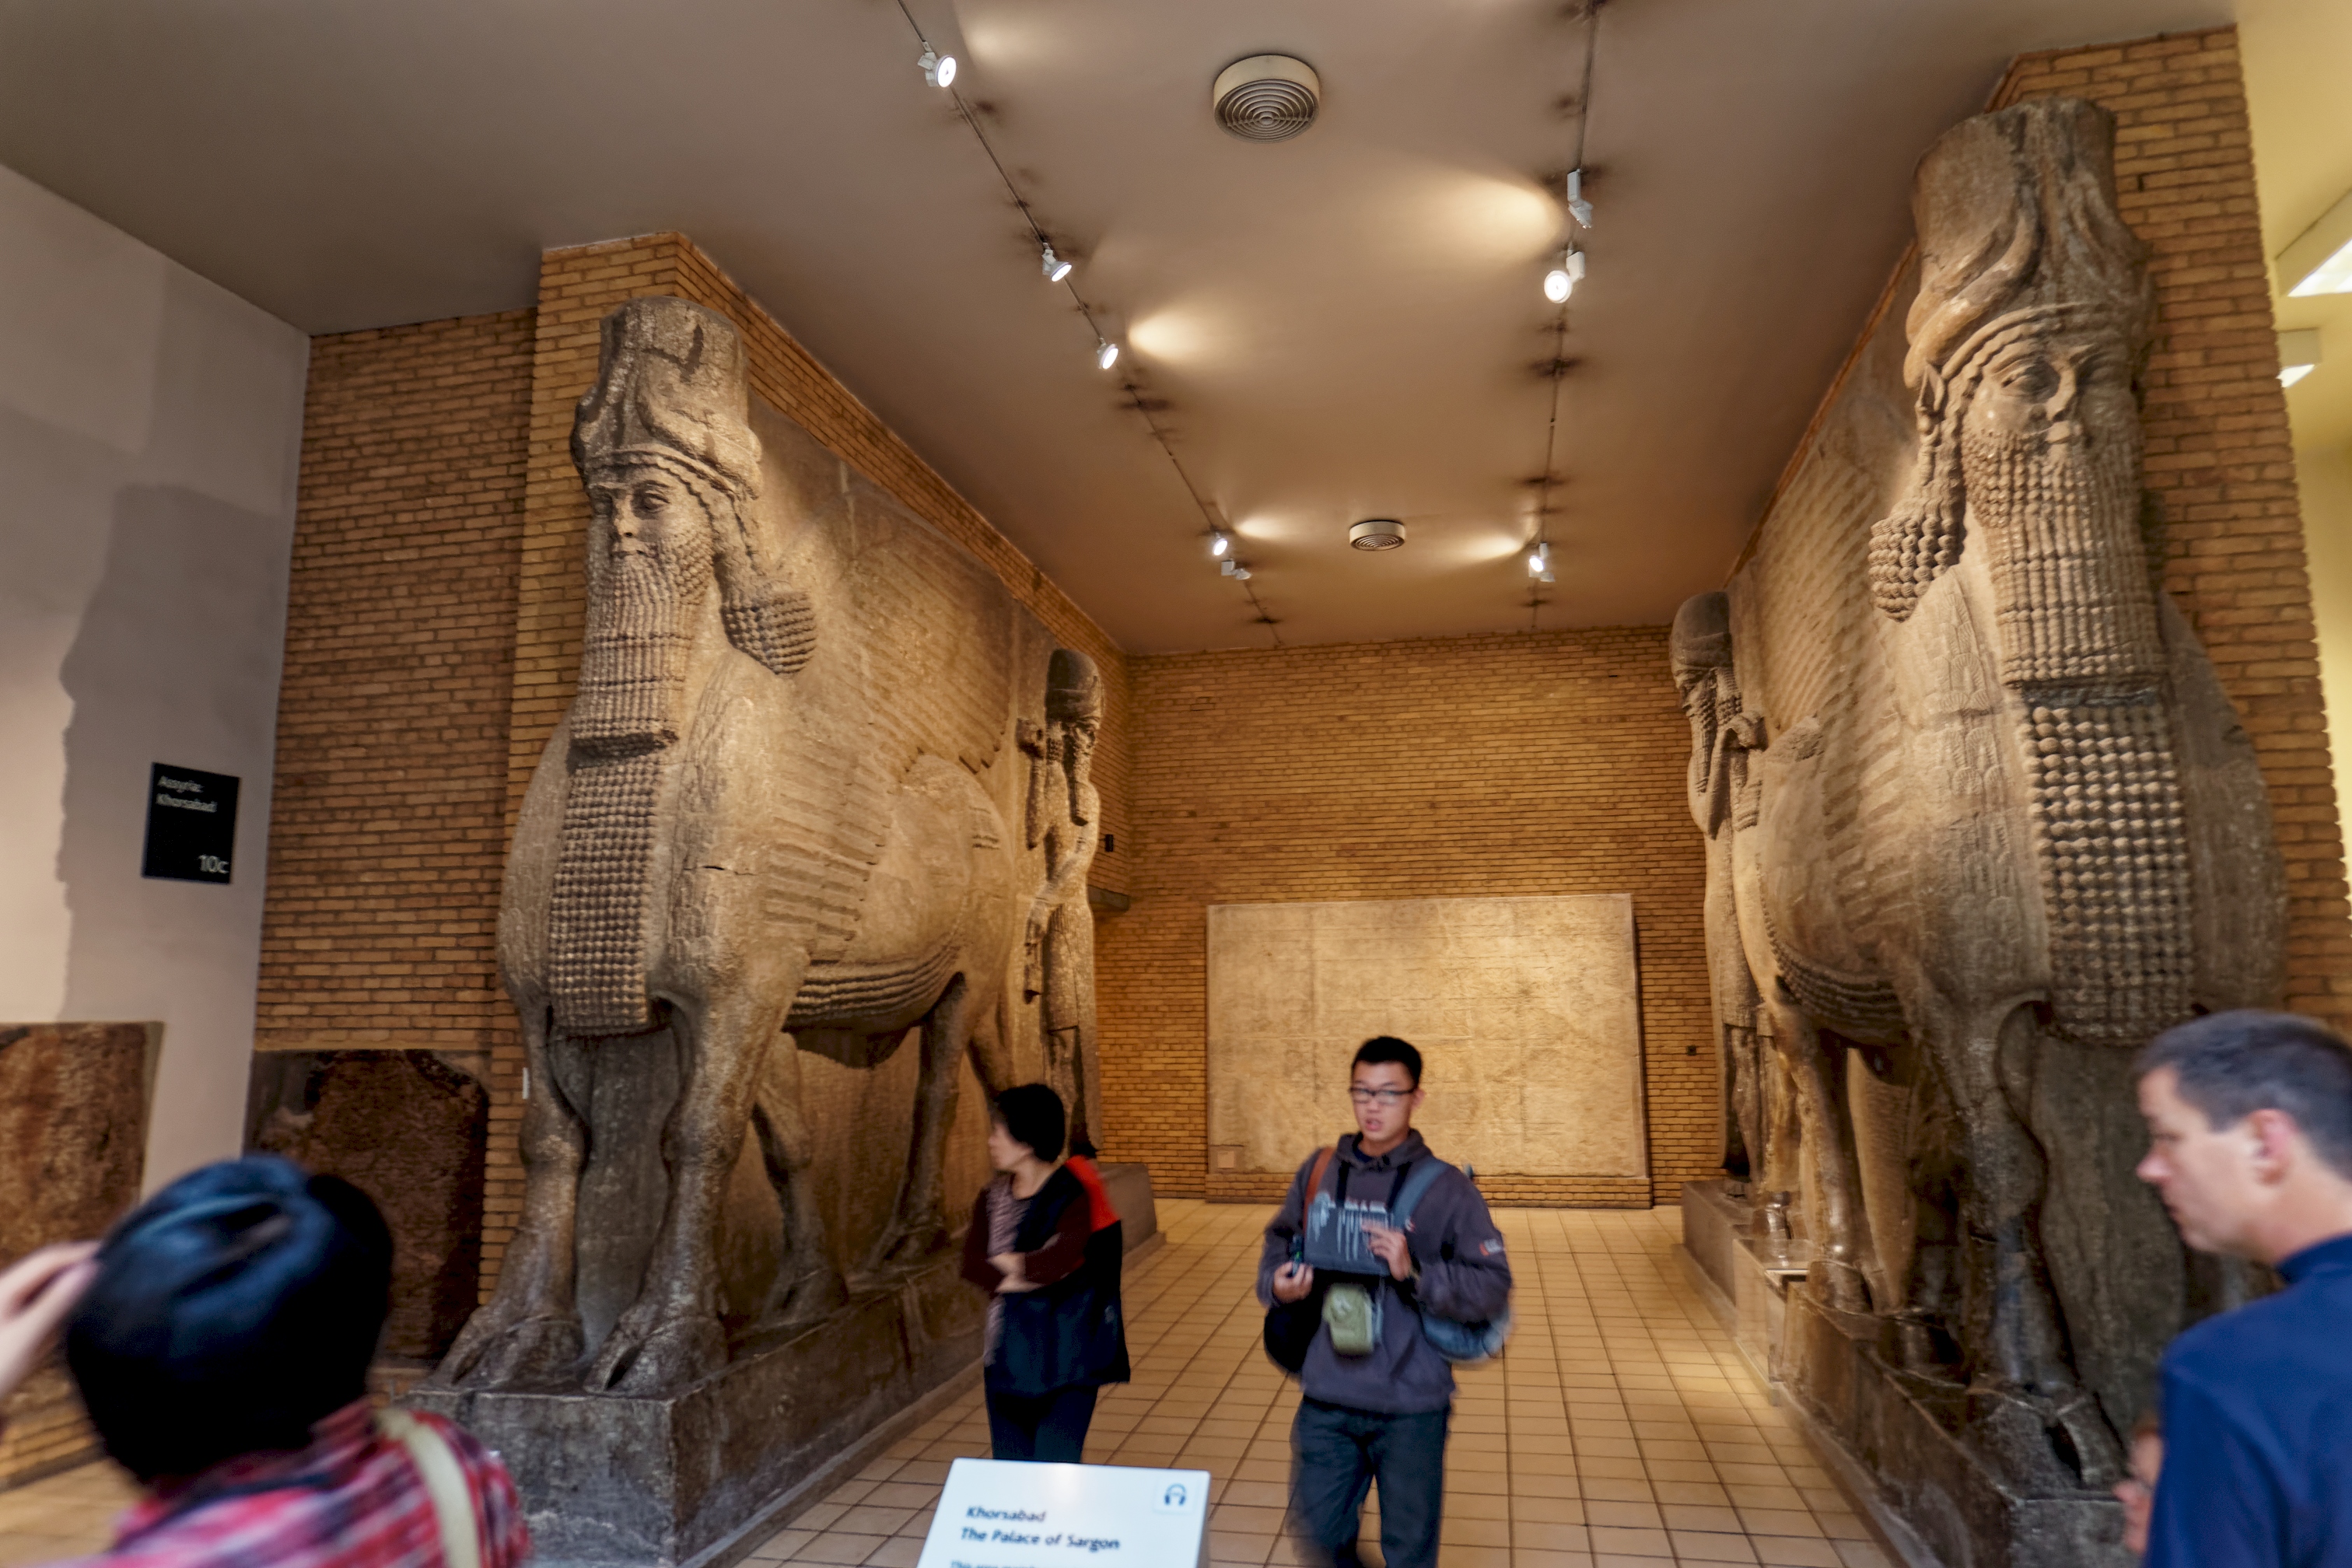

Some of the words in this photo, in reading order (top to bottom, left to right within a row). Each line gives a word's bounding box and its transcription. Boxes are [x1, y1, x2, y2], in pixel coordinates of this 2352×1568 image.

[198, 854, 229, 874] 10c
[966, 1506, 1047, 1523] Khorsabad
[961, 1526, 987, 1542] The
[992, 1529, 1041, 1545] Palace
[1045, 1533, 1062, 1546] of
[1066, 1535, 1121, 1553] Sargon
